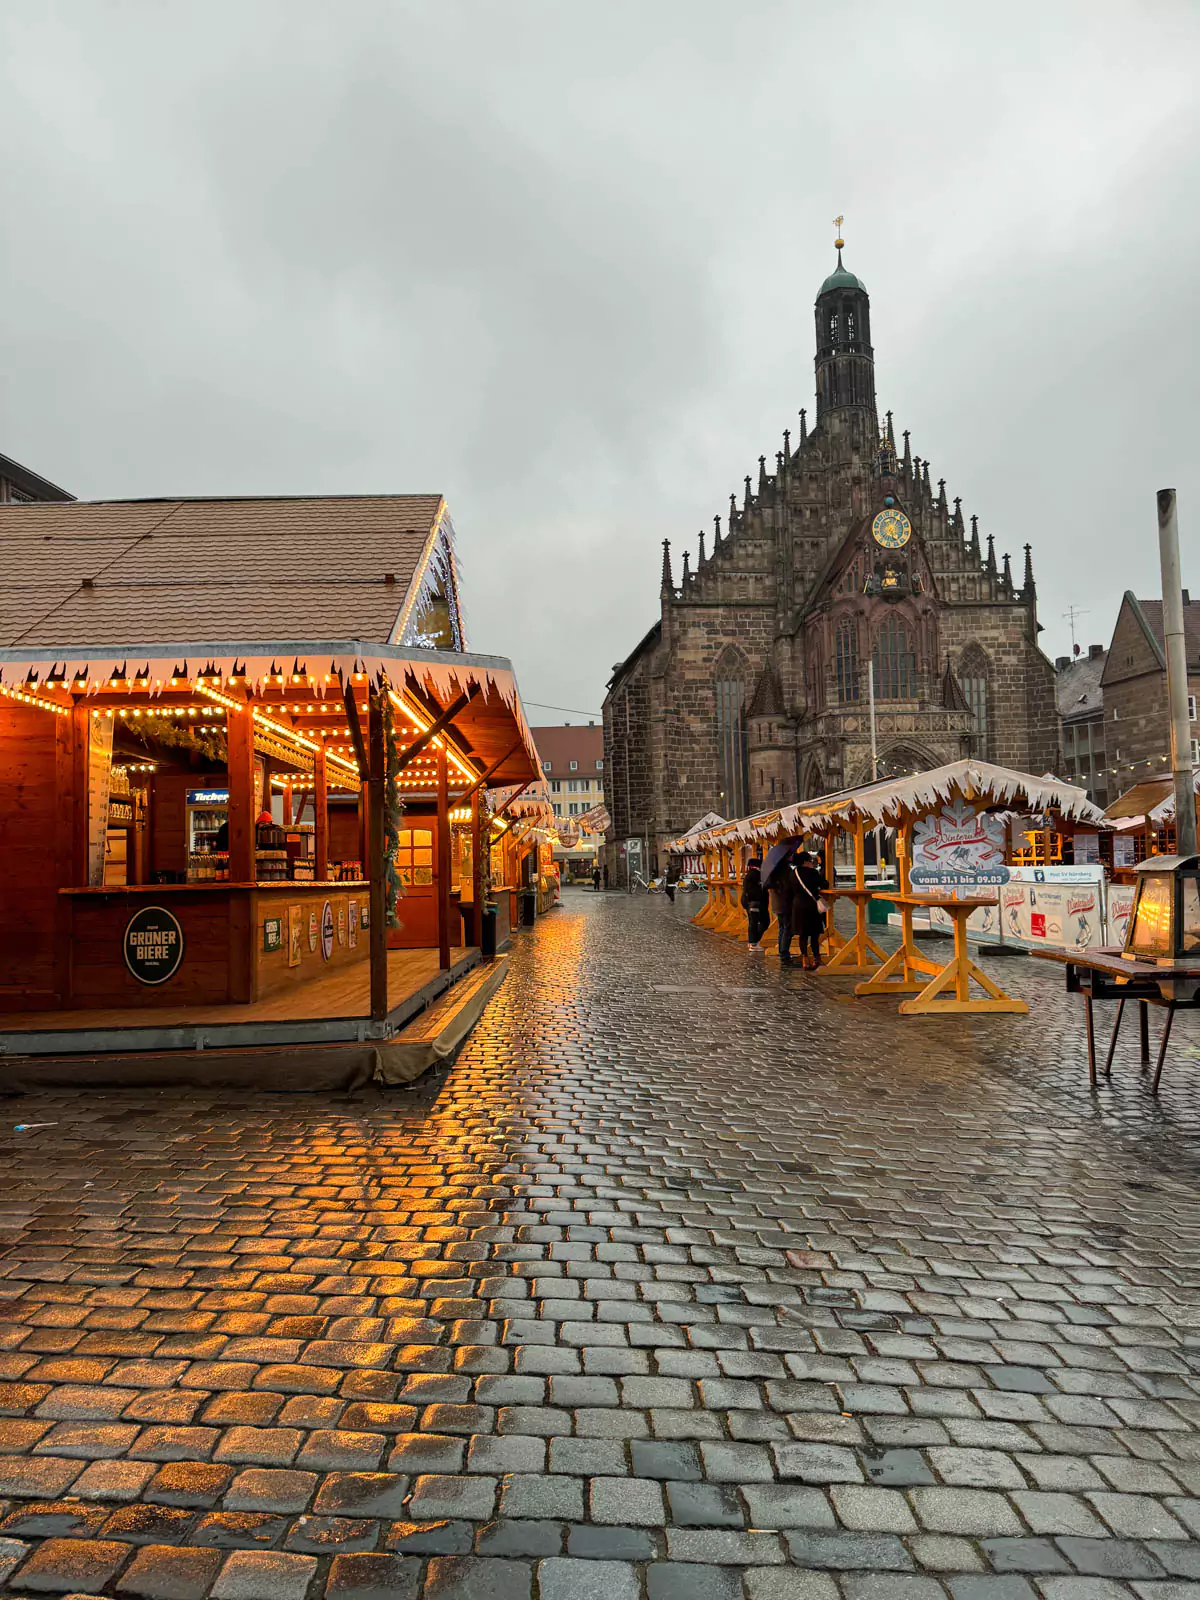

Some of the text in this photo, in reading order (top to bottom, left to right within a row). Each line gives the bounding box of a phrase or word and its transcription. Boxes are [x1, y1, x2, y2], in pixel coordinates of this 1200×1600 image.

[918, 876, 938, 884] vom
[941, 875, 957, 884] 31.1
[960, 875, 974, 884] bis
[977, 875, 1003, 884] 09.03
[130, 930, 177, 946] GRÜNER
[136, 946, 169, 960] BIERE
